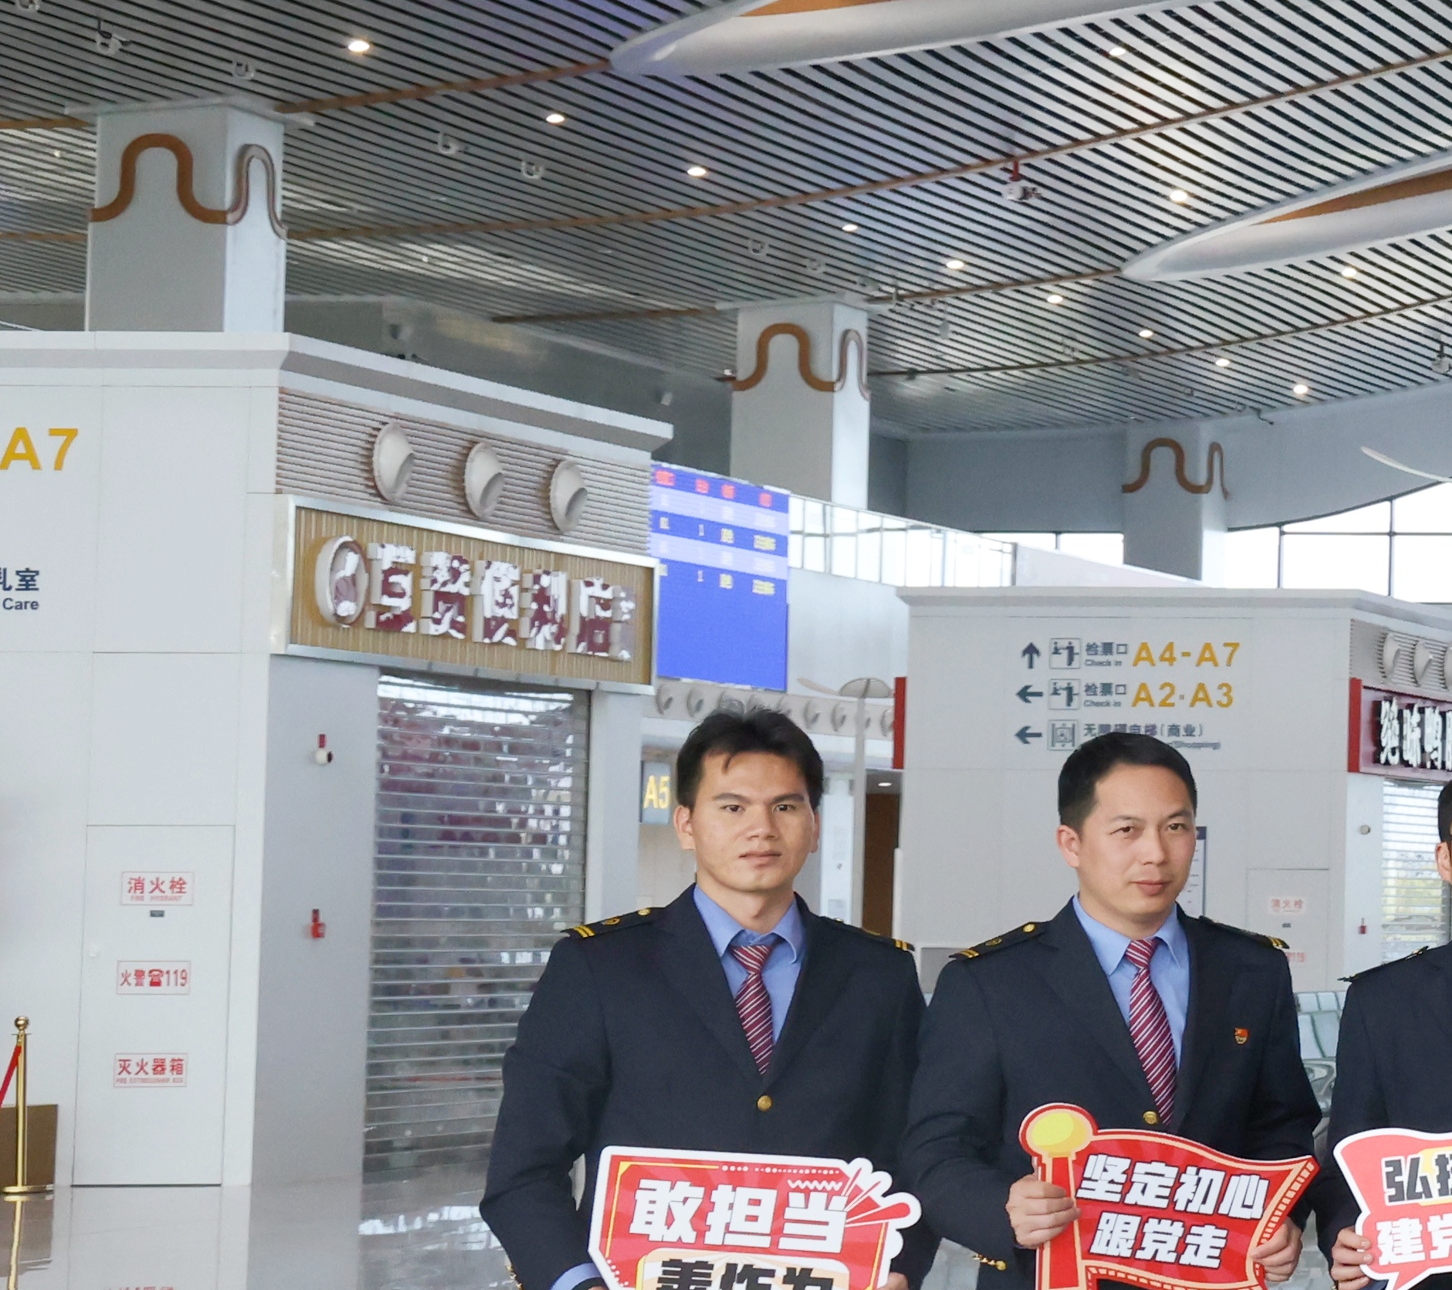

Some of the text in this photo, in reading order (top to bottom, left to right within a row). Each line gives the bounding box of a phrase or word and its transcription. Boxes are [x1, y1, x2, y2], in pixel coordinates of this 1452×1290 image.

[0, 427, 78, 471] A7
[2, 597, 39, 610] Care
[1085, 642, 1128, 656] 检票口
[1132, 642, 1240, 667] A4-A7
[1084, 683, 1127, 696] 检票口
[643, 775, 671, 810] A5
[128, 876, 187, 894] 消火栓
[121, 969, 188, 987] 火警 119
[118, 1058, 184, 1075] 灭火器箱
[1075, 1153, 1270, 1220] 坚定初心
[629, 1178, 849, 1254] 敢担当
[1089, 1211, 1229, 1269] 跟党走
